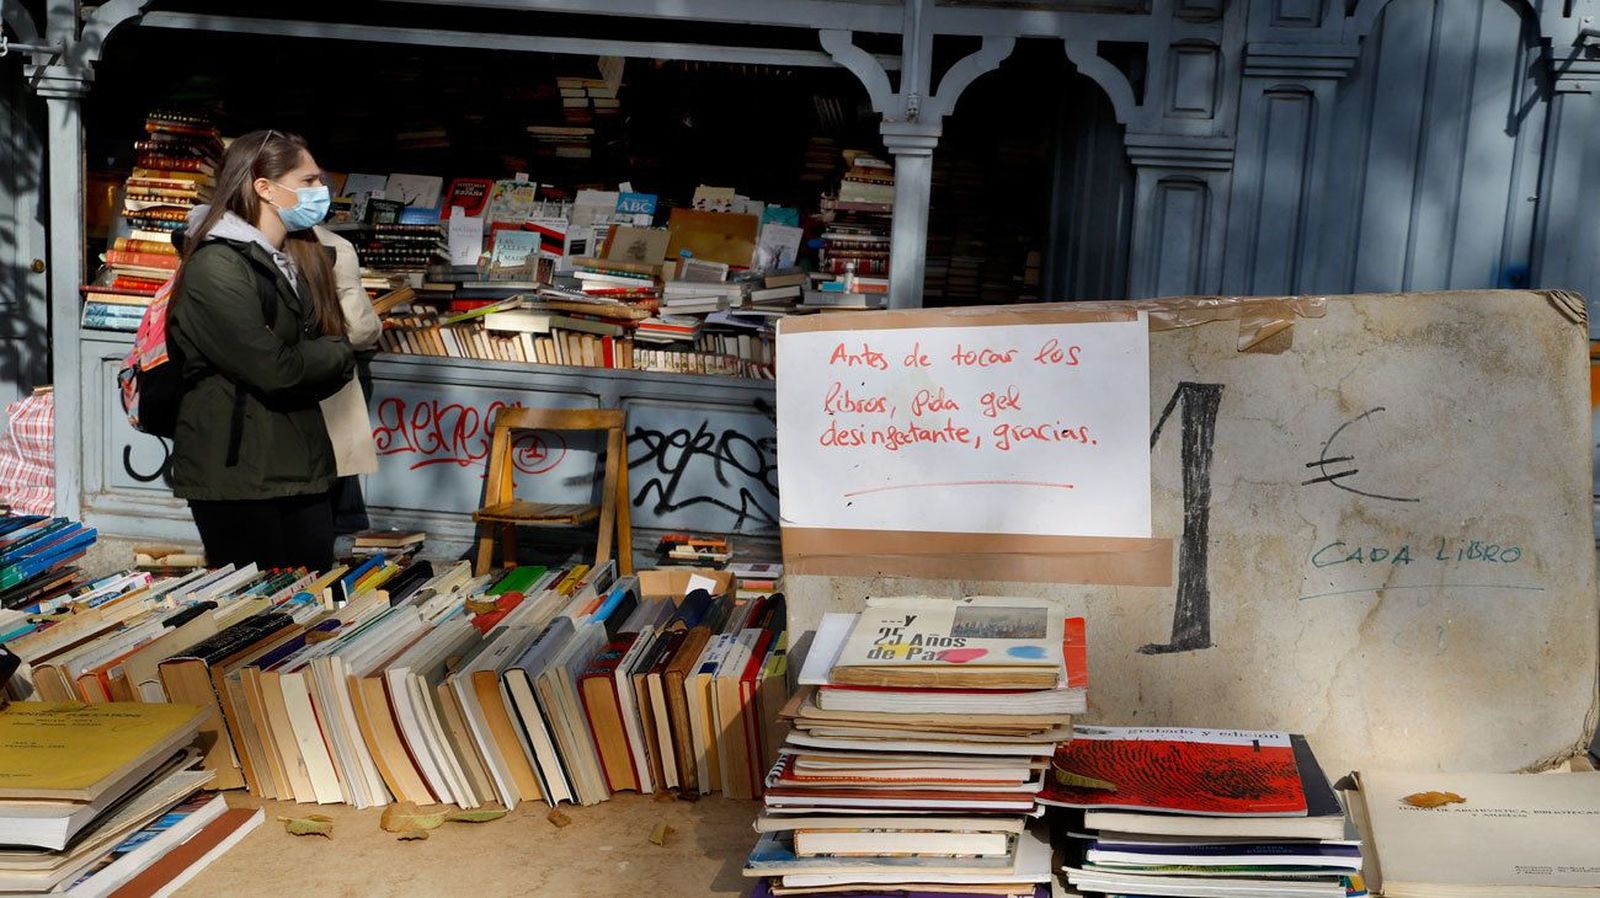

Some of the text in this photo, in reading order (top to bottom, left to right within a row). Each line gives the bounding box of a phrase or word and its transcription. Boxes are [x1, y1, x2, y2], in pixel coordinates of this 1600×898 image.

[617, 200, 653, 212] ABC
[830, 338, 1082, 371] Antes de tocar los
[823, 382, 896, 418] libros,
[980, 385, 1023, 418] gel
[993, 420, 1098, 451] gracias.
[1136, 381, 1421, 656] 1 €
[1311, 541, 1416, 568] CADA
[873, 627, 967, 648] 25 Años
[866, 646, 949, 662] de Paz
[1127, 728, 1195, 736] grabado
[1219, 731, 1280, 740] edición
